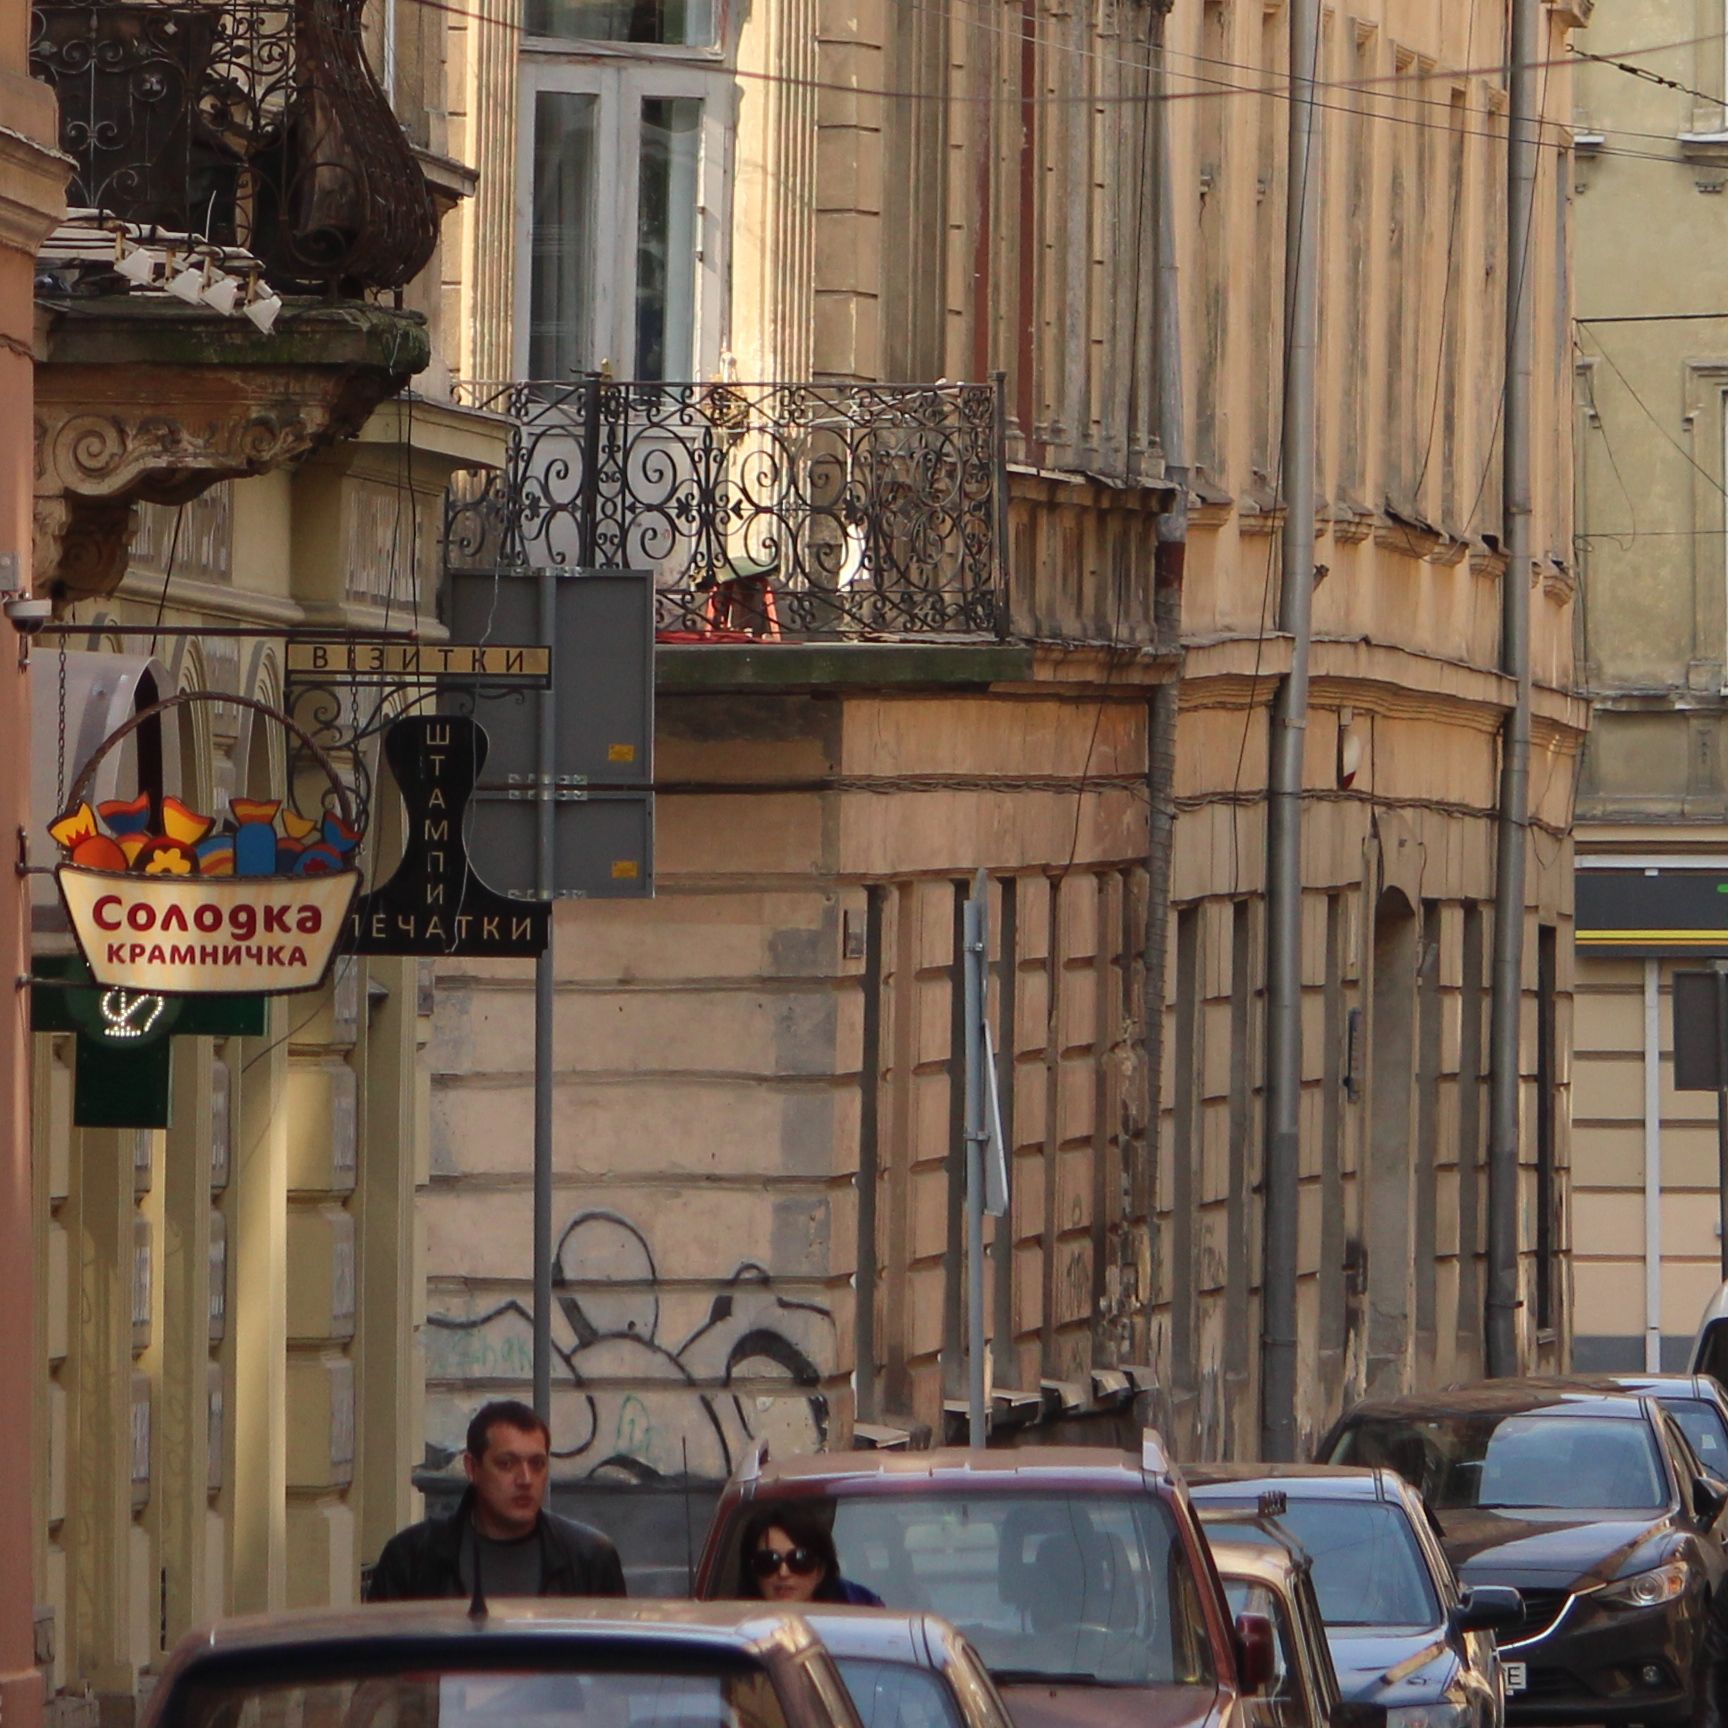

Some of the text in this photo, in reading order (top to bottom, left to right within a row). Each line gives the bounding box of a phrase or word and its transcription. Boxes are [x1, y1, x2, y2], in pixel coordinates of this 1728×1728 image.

[312, 647, 524, 672] ВІЗИТКИ
[424, 724, 451, 905] ШТАМПИ
[92, 894, 323, 942] Солодка
[106, 943, 308, 967] КРАМНИЧКА
